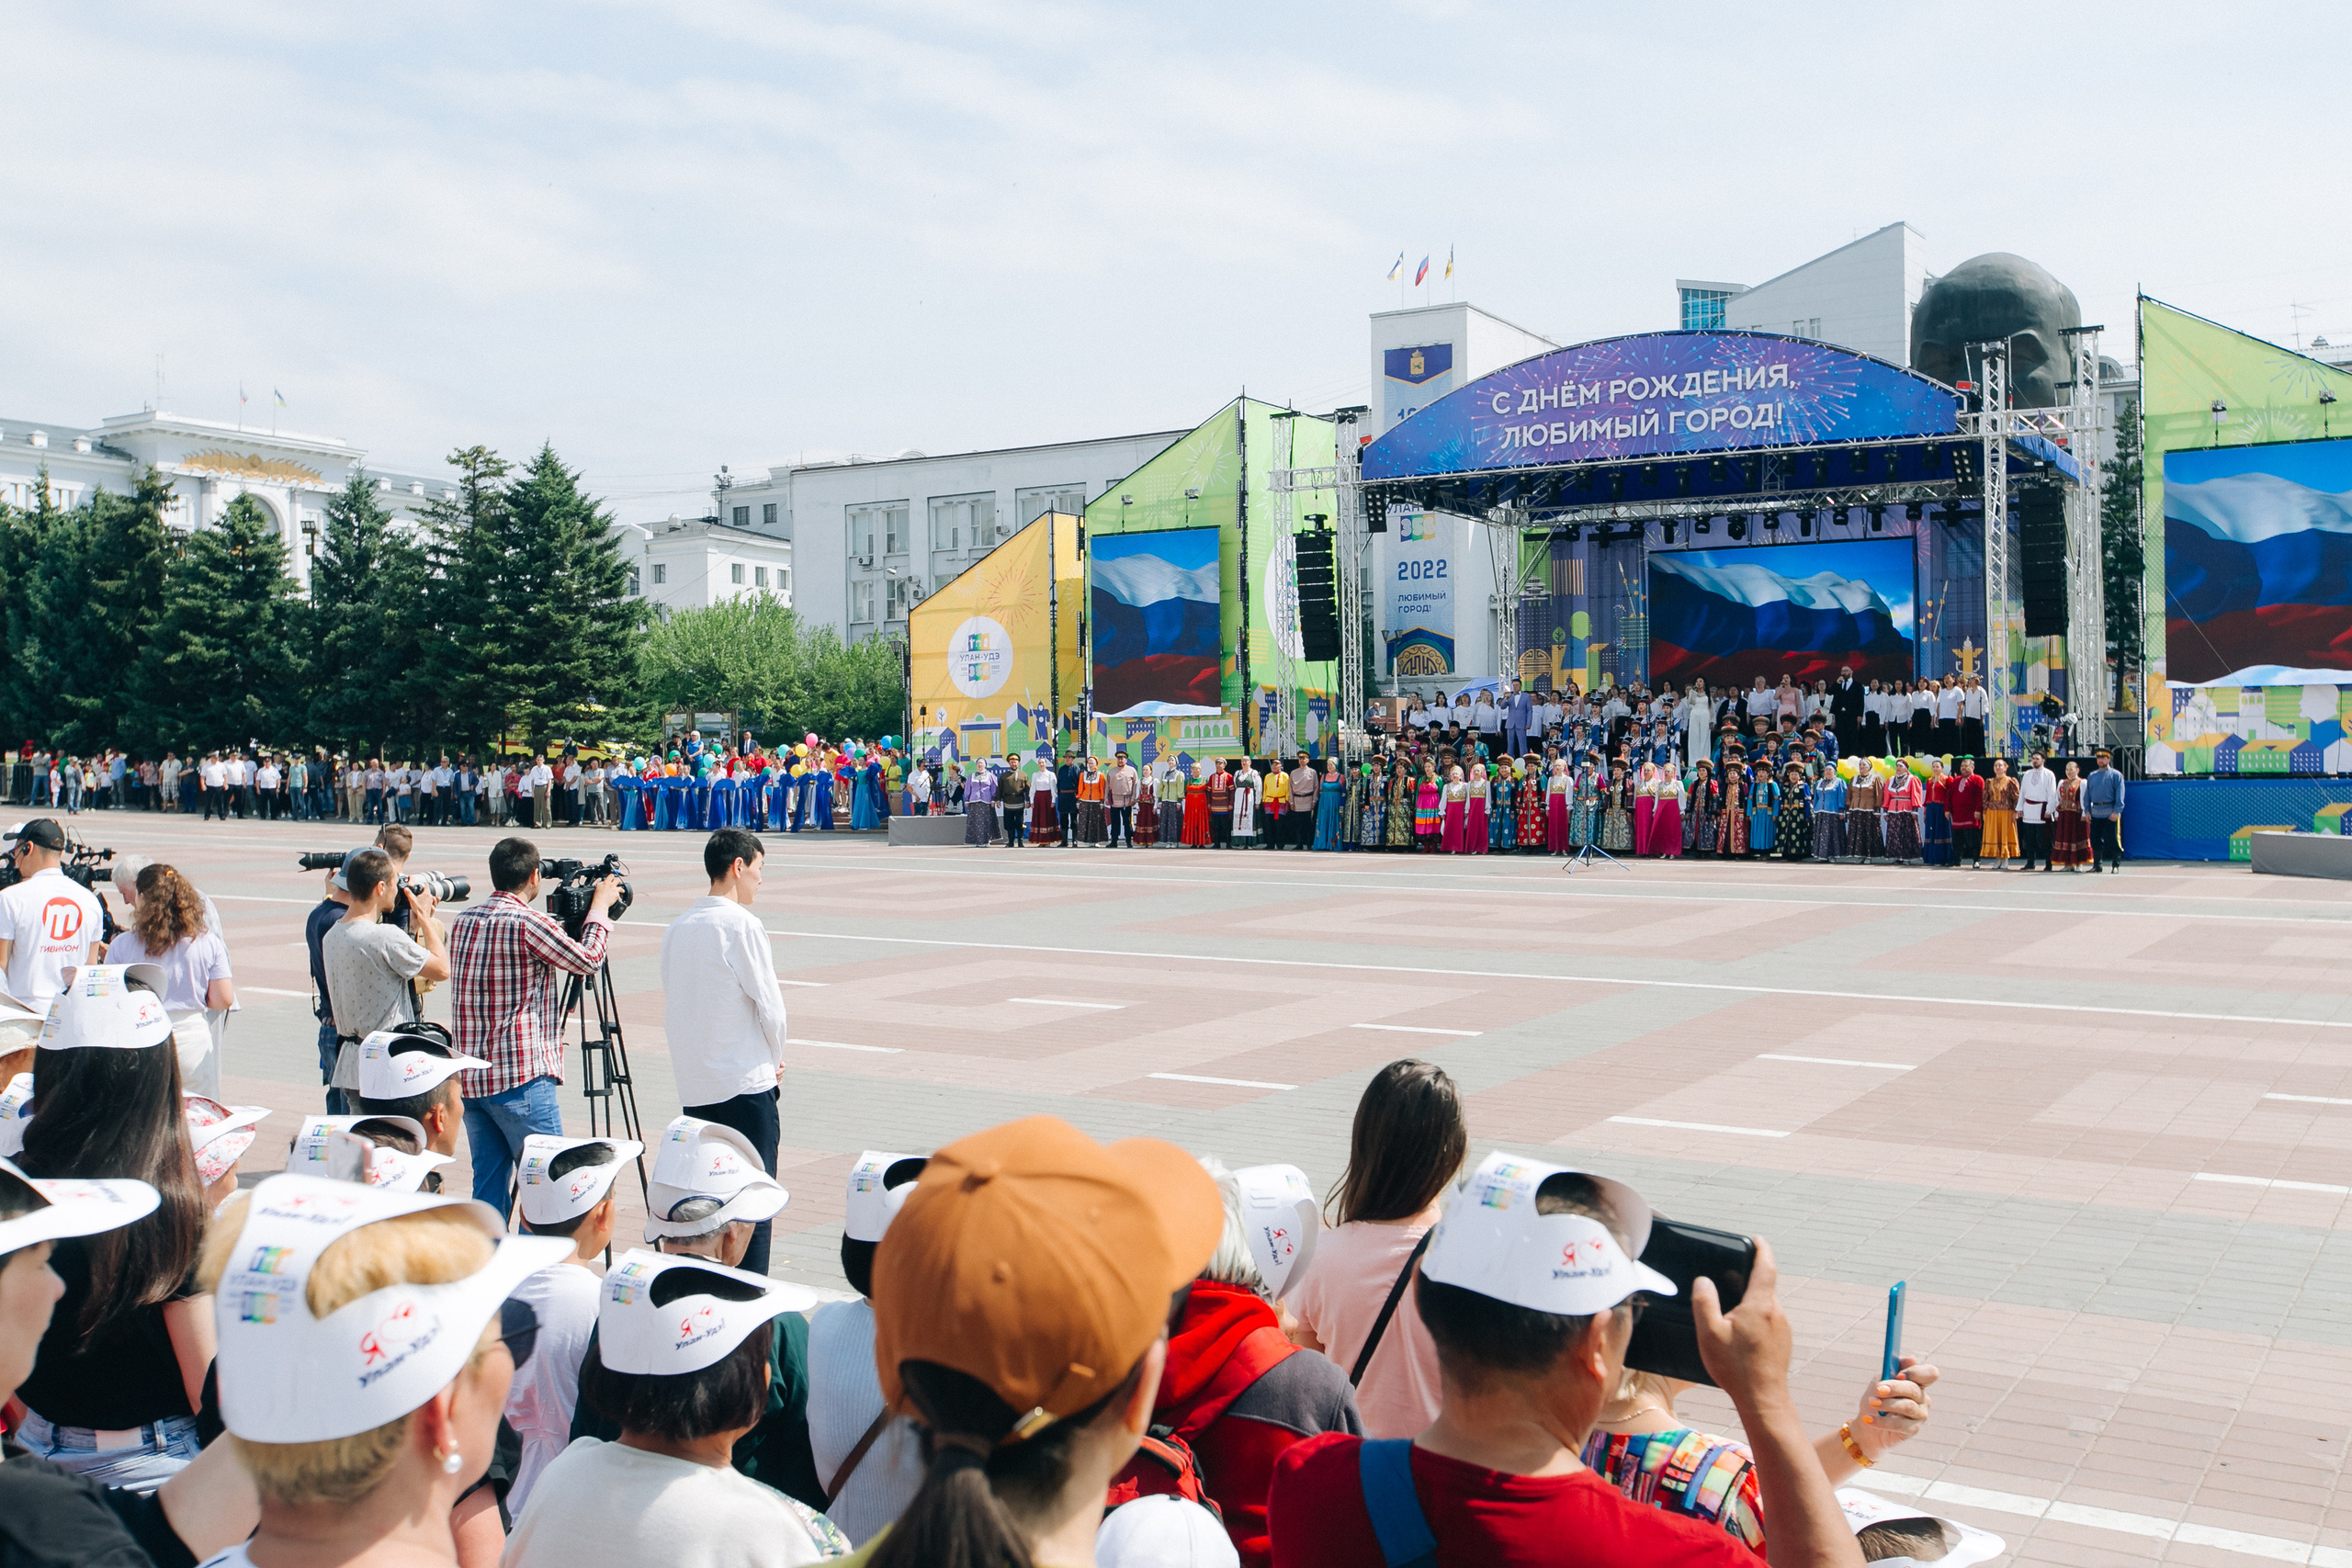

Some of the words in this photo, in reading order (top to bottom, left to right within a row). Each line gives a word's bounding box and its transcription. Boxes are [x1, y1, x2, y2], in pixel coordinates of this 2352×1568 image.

[1492, 391, 1511, 414] С
[1517, 380, 1600, 414] ДНЁМ
[1609, 364, 1795, 403] РОЖДЕНИЯ,
[1501, 408, 1659, 449] ЛЮБИМЫЙ
[1668, 401, 1782, 434] ГОРОД!
[1387, 503, 1419, 513] УЛАН
[1398, 558, 1447, 581] 2022
[1397, 591, 1446, 602] ЛЮБИМЫЙ
[1397, 604, 1431, 614] ГОРОД!
[959, 652, 1001, 661] УЛАН-УДЭ
[40, 944, 79, 953] ТИВИКОМ
[713, 1156, 721, 1169] Я
[571, 1183, 581, 1196] Я
[1562, 1242, 1577, 1268] Я
[675, 1317, 726, 1350] Улан-Удэ!
[681, 1318, 694, 1338] Я
[359, 1332, 386, 1366] Я
